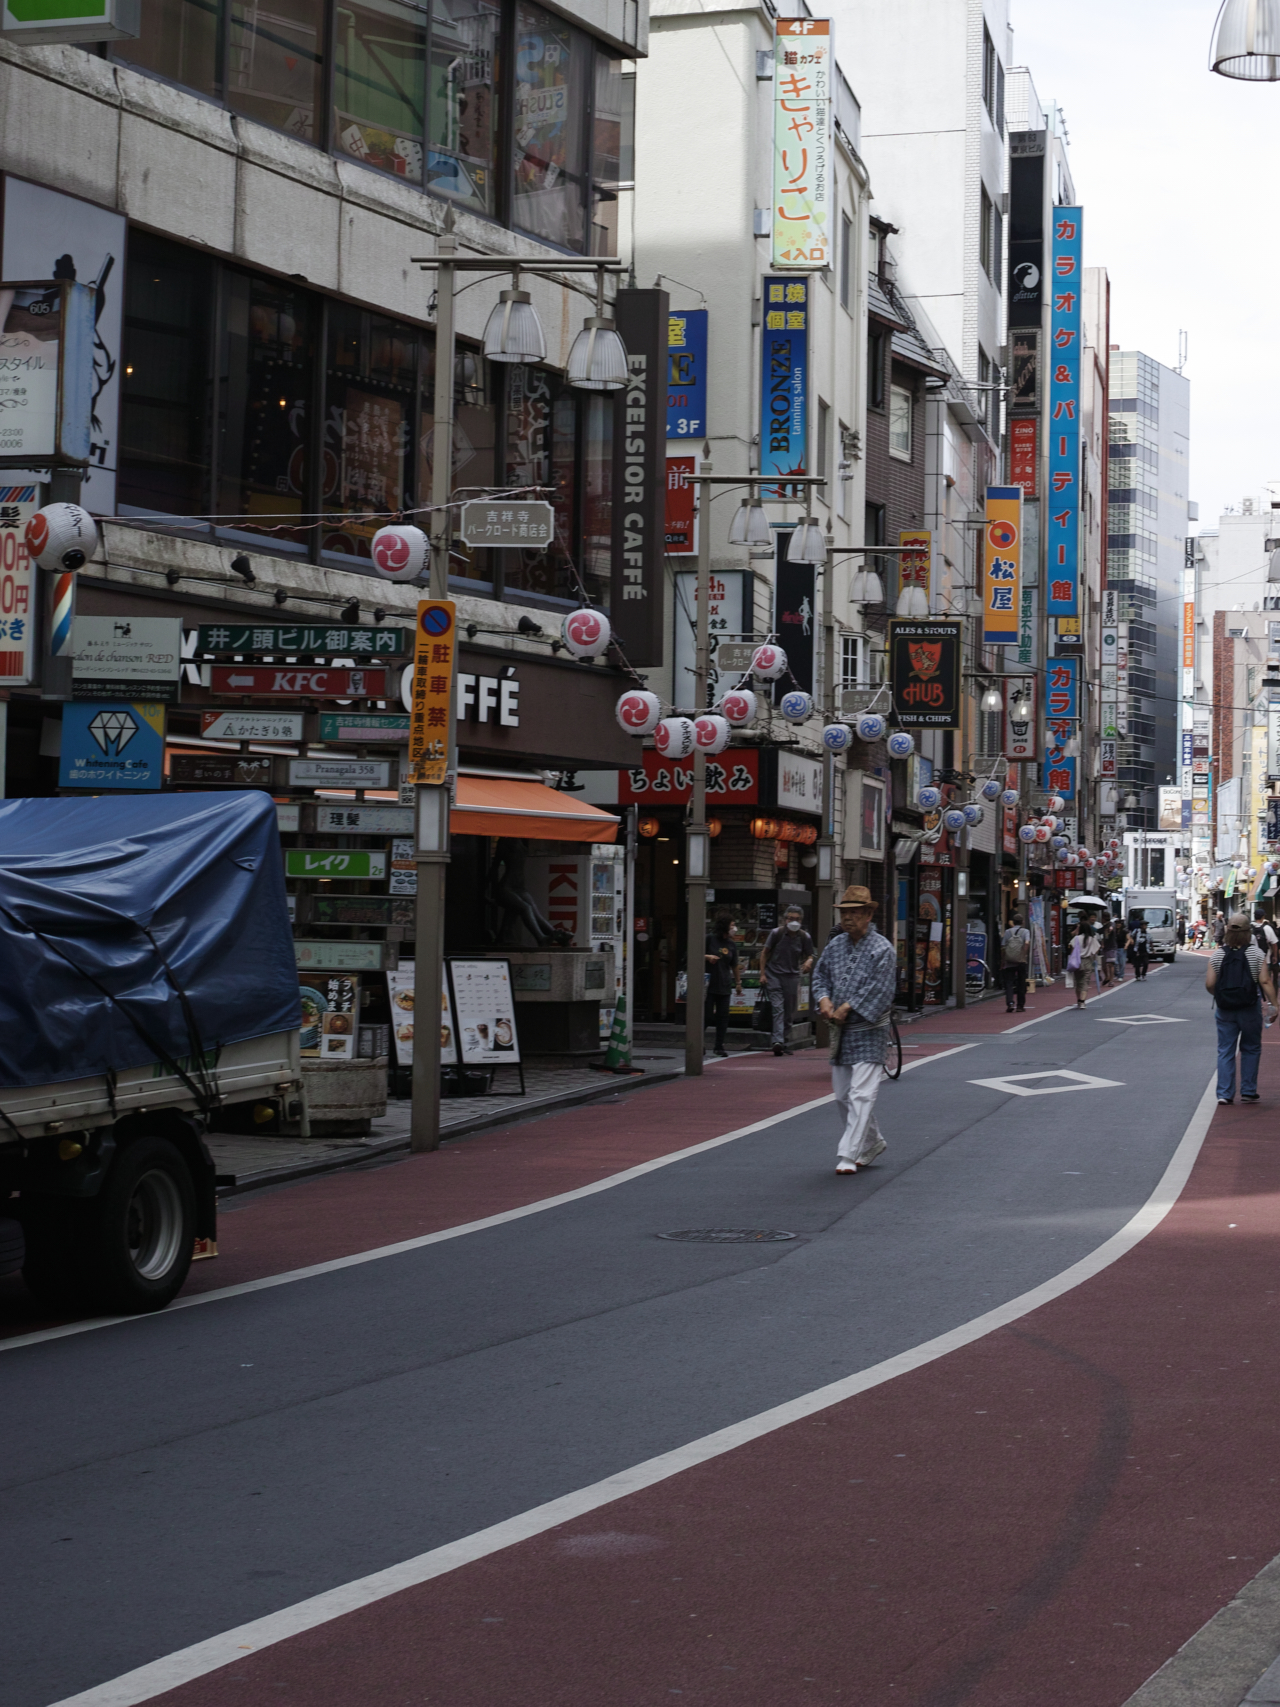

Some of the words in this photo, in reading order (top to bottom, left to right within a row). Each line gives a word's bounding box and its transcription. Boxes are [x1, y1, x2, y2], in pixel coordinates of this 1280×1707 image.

[789, 21, 814, 34] 4F
[784, 51, 822, 65] 猫カフェ
[779, 73, 814, 221] きゃりこ
[792, 248, 824, 261] 入口
[769, 284, 806, 304] 日焼
[29, 303, 50, 315] 605
[766, 311, 806, 330] 個室
[792, 367, 802, 393] salon
[769, 339, 792, 454] BRONZE
[791, 394, 804, 435] tanning
[624, 354, 647, 503] EXCELSIOR
[677, 419, 700, 434] 3F
[486, 511, 530, 523] 吉祥寺
[467, 524, 548, 538] パークロード商店会
[622, 512, 648, 600] CAFFÉ
[989, 557, 1015, 611] 松屋
[925, 627, 957, 635] STOUTS
[207, 629, 396, 652] 井ノ頭ビル御案内
[271, 673, 328, 692] KFC
[903, 682, 944, 707] HUB
[205, 714, 215, 722] 5F
[898, 714, 917, 722] FISH
[926, 715, 951, 723] CHIPS
[238, 725, 293, 738] かたぎり塾
[75, 759, 148, 770] WhiteningCafe
[358, 765, 374, 775] 358
[69, 770, 151, 780] 歯のホワイトニング
[628, 763, 753, 793] ちょい飲み
[305, 854, 350, 871] レイク
[372, 866, 384, 876] 2F
